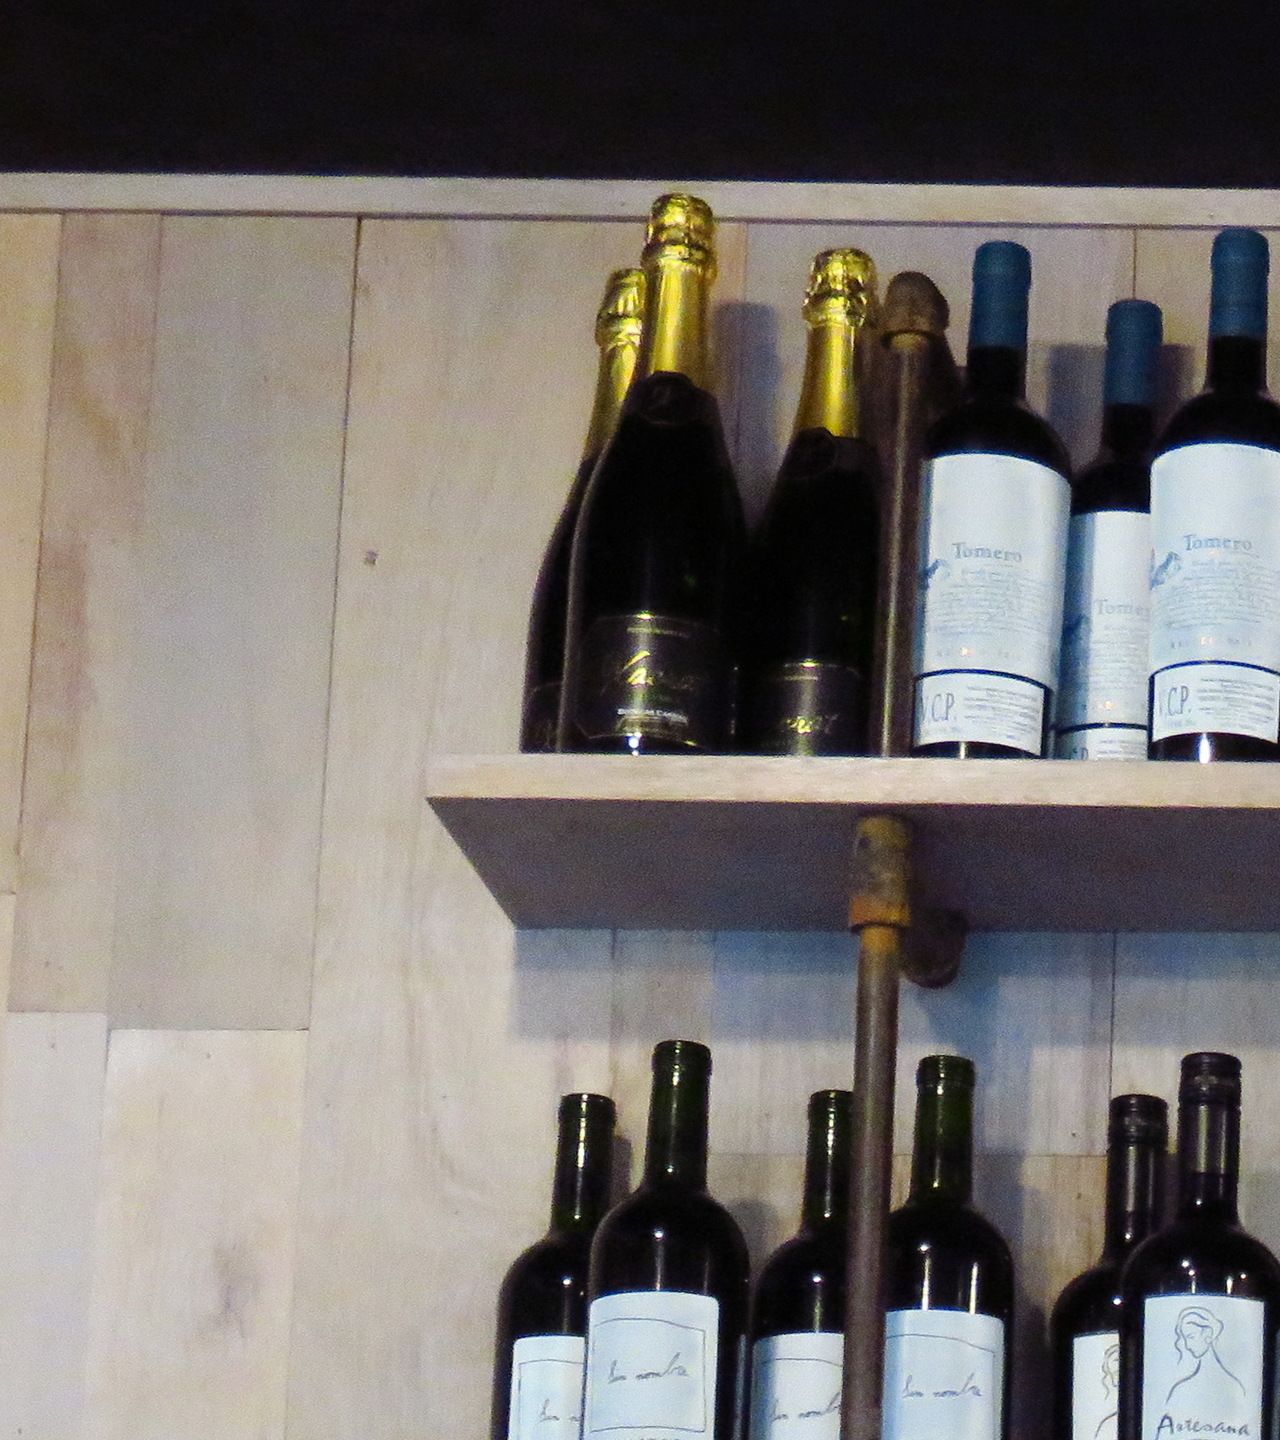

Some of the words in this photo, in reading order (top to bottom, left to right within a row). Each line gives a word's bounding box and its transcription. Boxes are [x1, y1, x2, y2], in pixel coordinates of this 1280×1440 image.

[953, 541, 1023, 563] Tomero
[1184, 533, 1252, 555] Tomero
[1095, 599, 1149, 617] Tome
